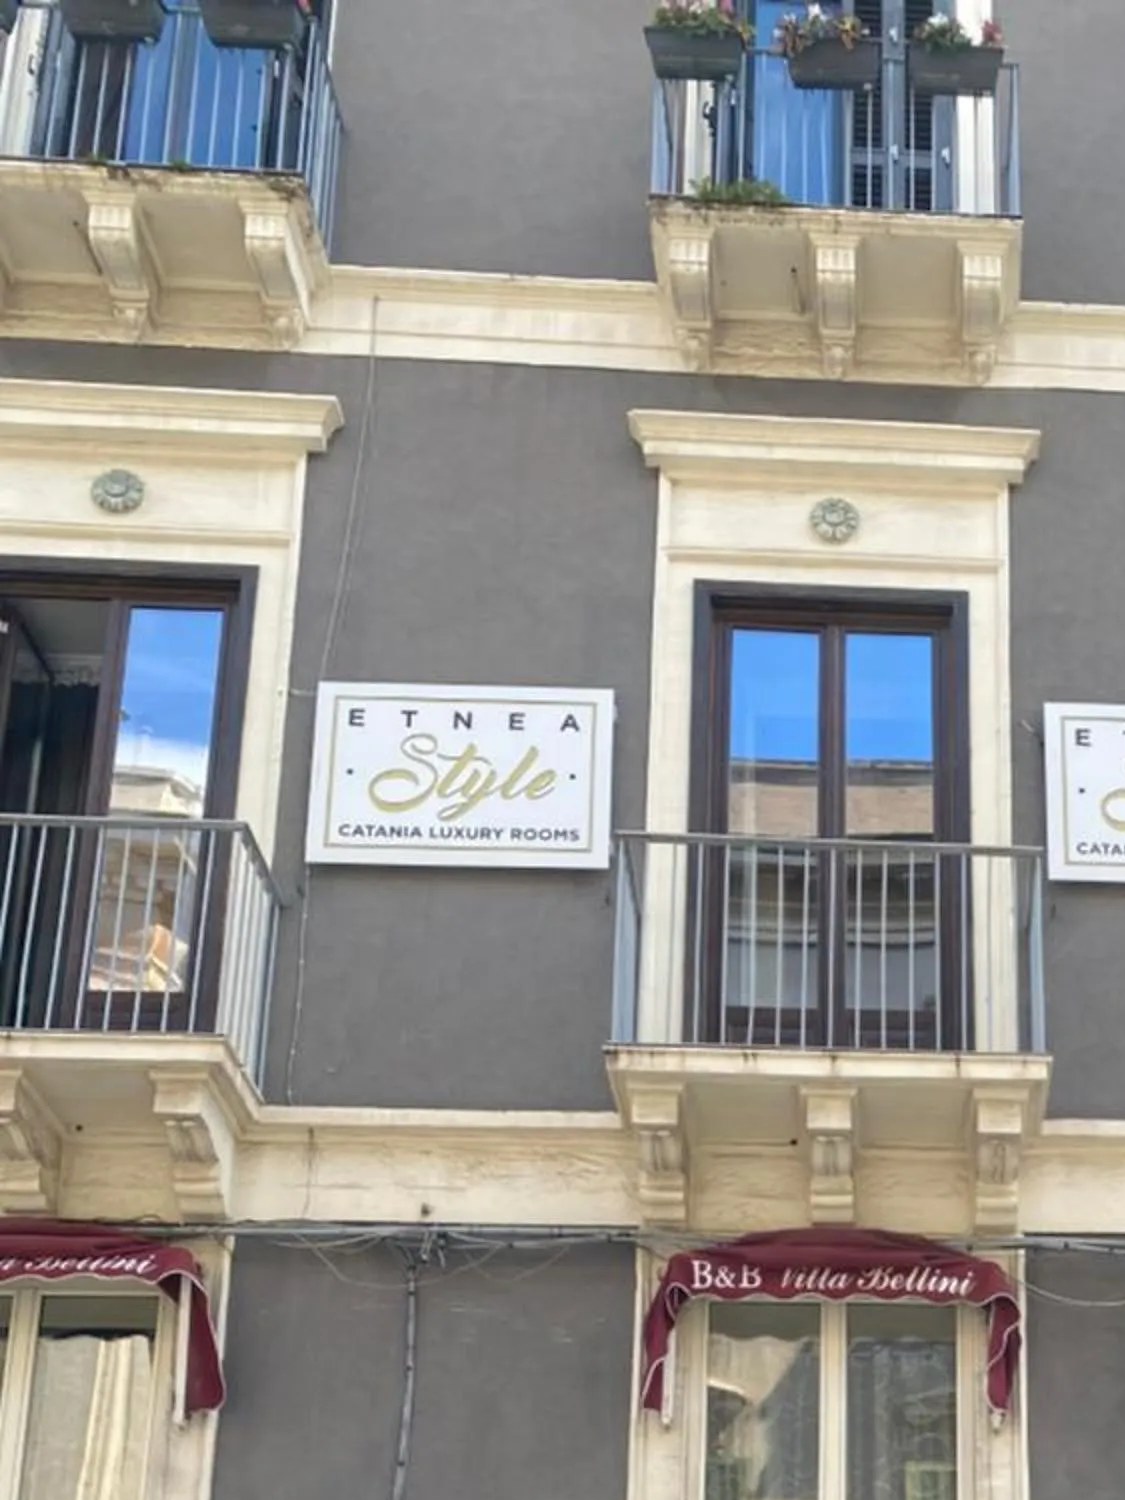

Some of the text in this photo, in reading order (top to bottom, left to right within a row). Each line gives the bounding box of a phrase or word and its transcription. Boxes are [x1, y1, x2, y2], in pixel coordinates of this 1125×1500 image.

[348, 708, 580, 732] ETNEA
[368, 733, 558, 822] Style
[338, 823, 580, 842] CATANIA LUXURY ROOMS
[691, 1260, 762, 1290] B&B
